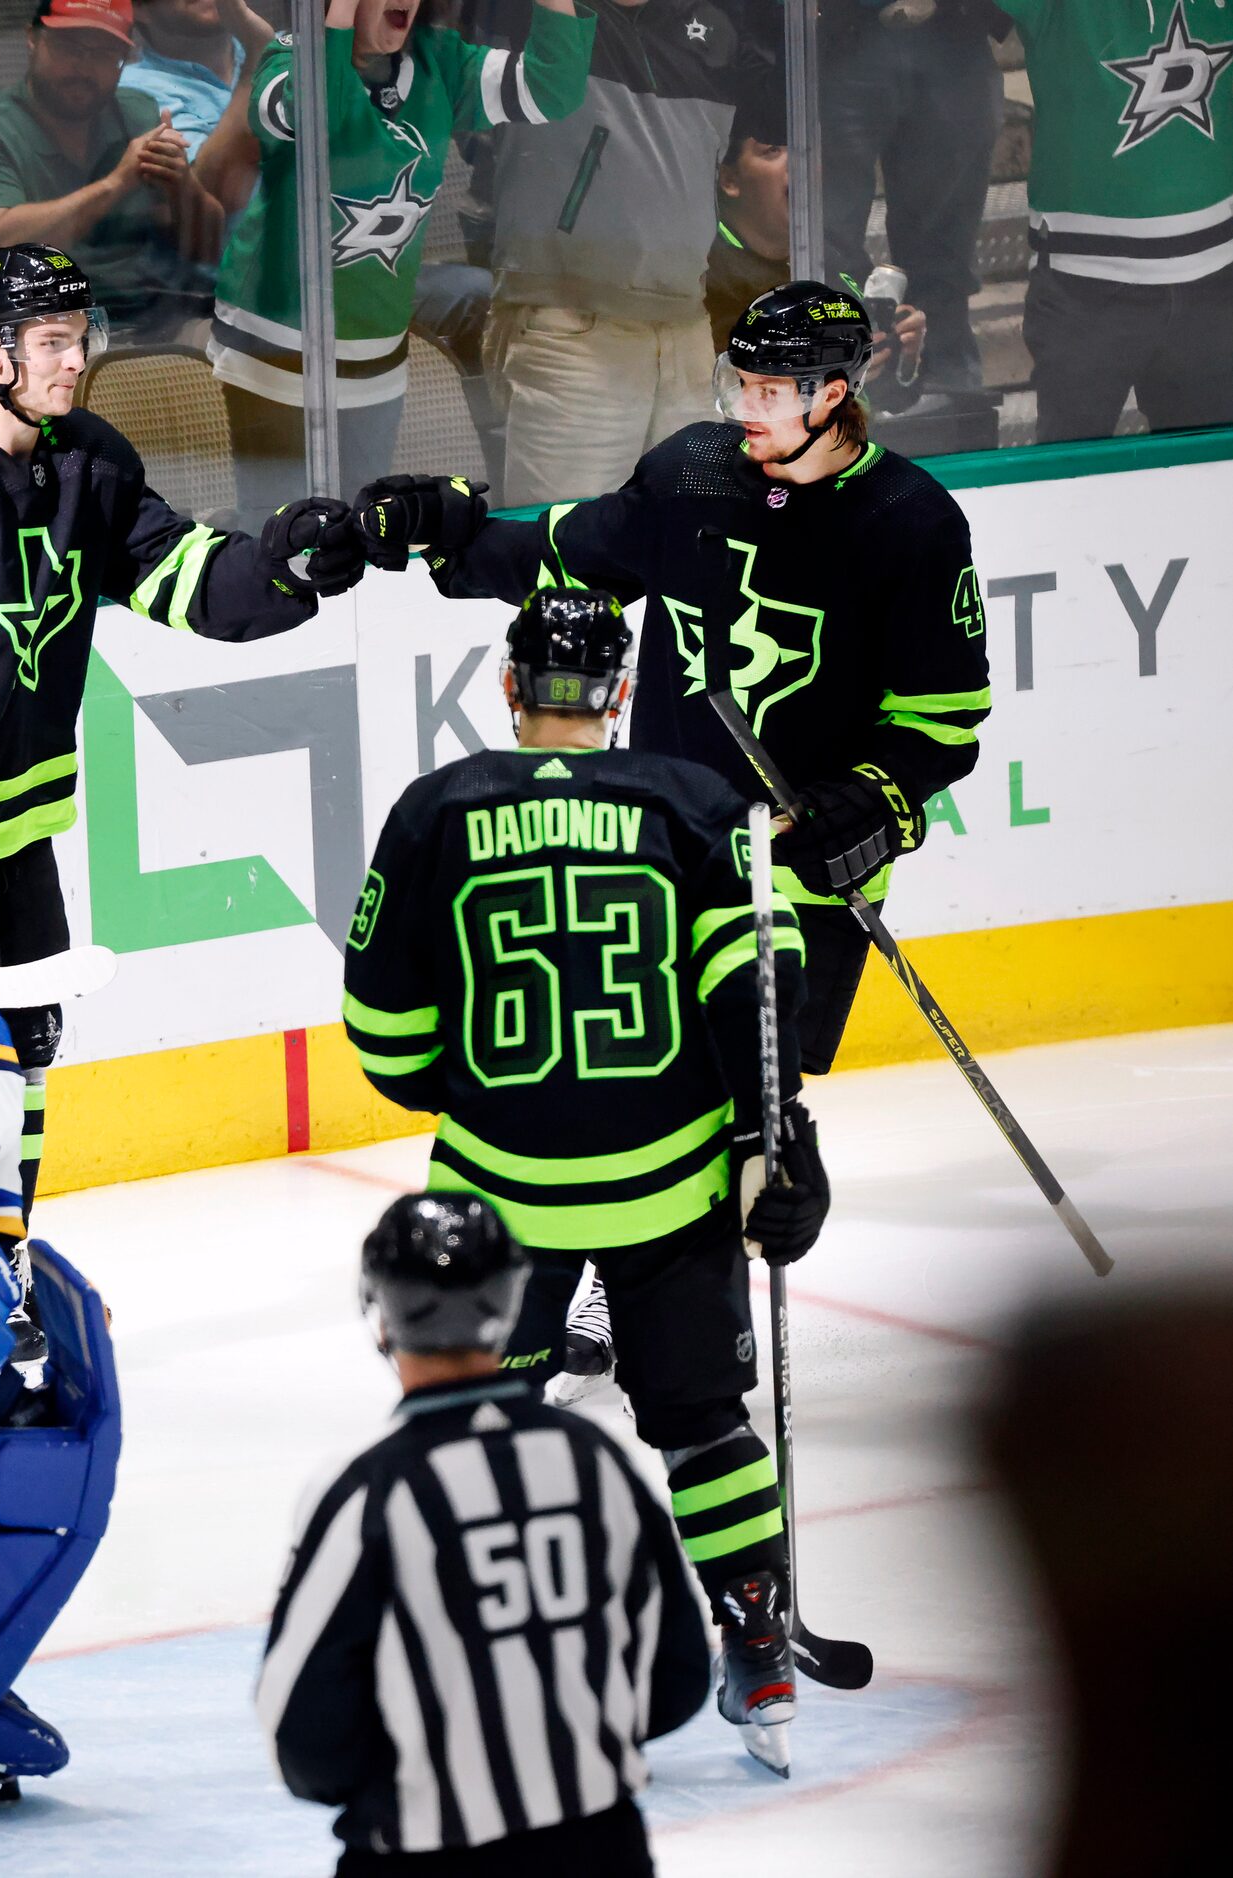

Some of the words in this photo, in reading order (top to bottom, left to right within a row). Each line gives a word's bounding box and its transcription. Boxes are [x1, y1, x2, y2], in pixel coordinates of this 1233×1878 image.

[59, 281, 87, 293] CCM
[823, 302, 851, 311] ENERGY
[825, 310, 861, 319] TRANSFER
[731, 337, 757, 352] CCM
[375, 505, 387, 538] CCM
[952, 565, 984, 638] 4
[551, 677, 582, 702] 63
[746, 753, 774, 788] CCM
[852, 763, 916, 848] CCM
[466, 798, 642, 862] DADONOV
[452, 864, 682, 1090] 63
[928, 1008, 966, 1058] SUPER
[962, 1049, 1017, 1133] TACKS
[497, 1348, 552, 1369] UER
[462, 1513, 588, 1632] 50
